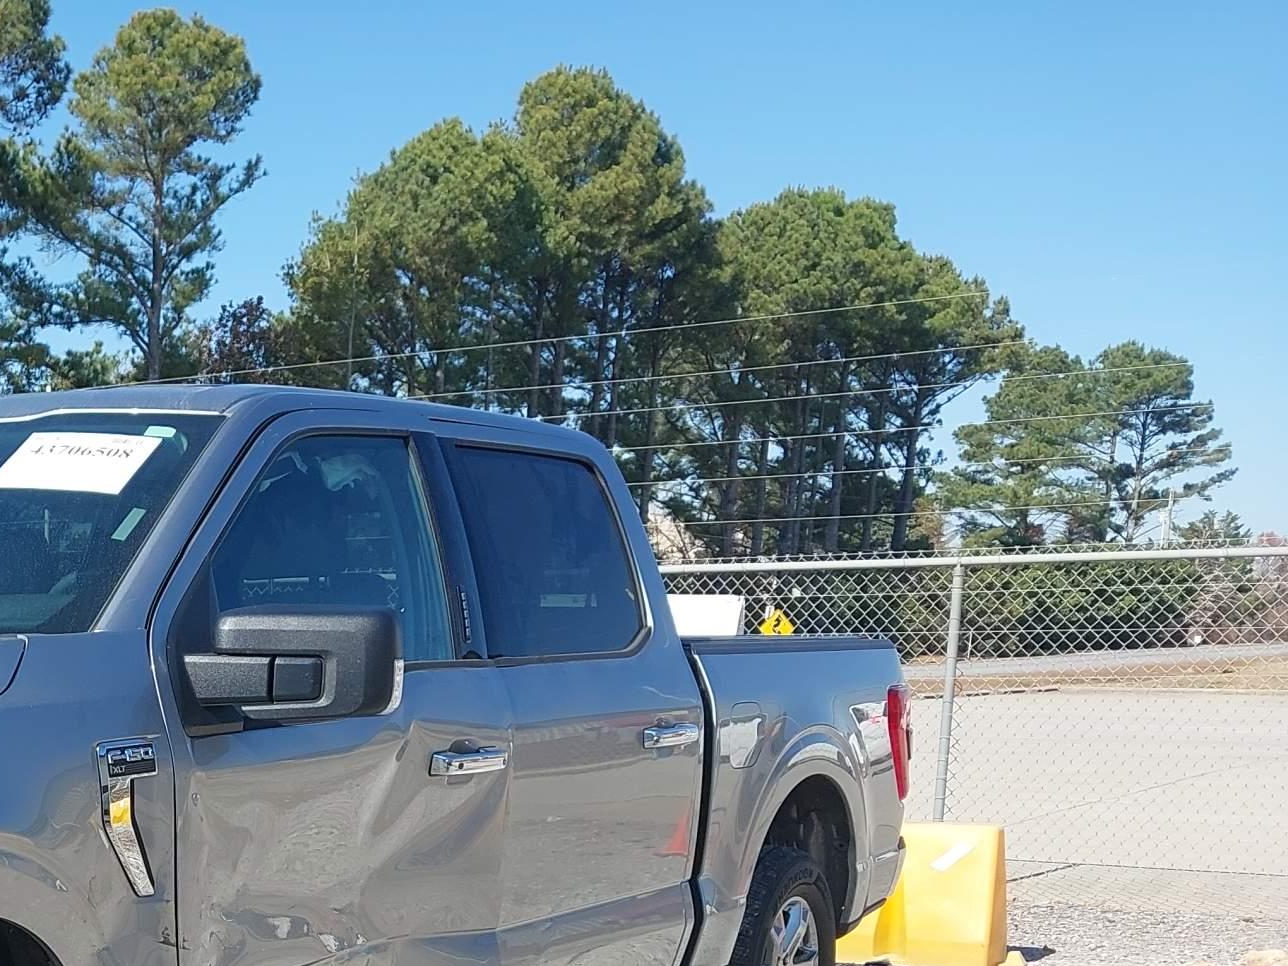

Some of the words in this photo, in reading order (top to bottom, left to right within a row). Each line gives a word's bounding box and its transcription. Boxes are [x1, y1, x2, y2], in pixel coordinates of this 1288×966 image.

[30, 444, 134, 459] 43706508
[107, 747, 154, 764] F-150
[112, 765, 126, 775] XLT
